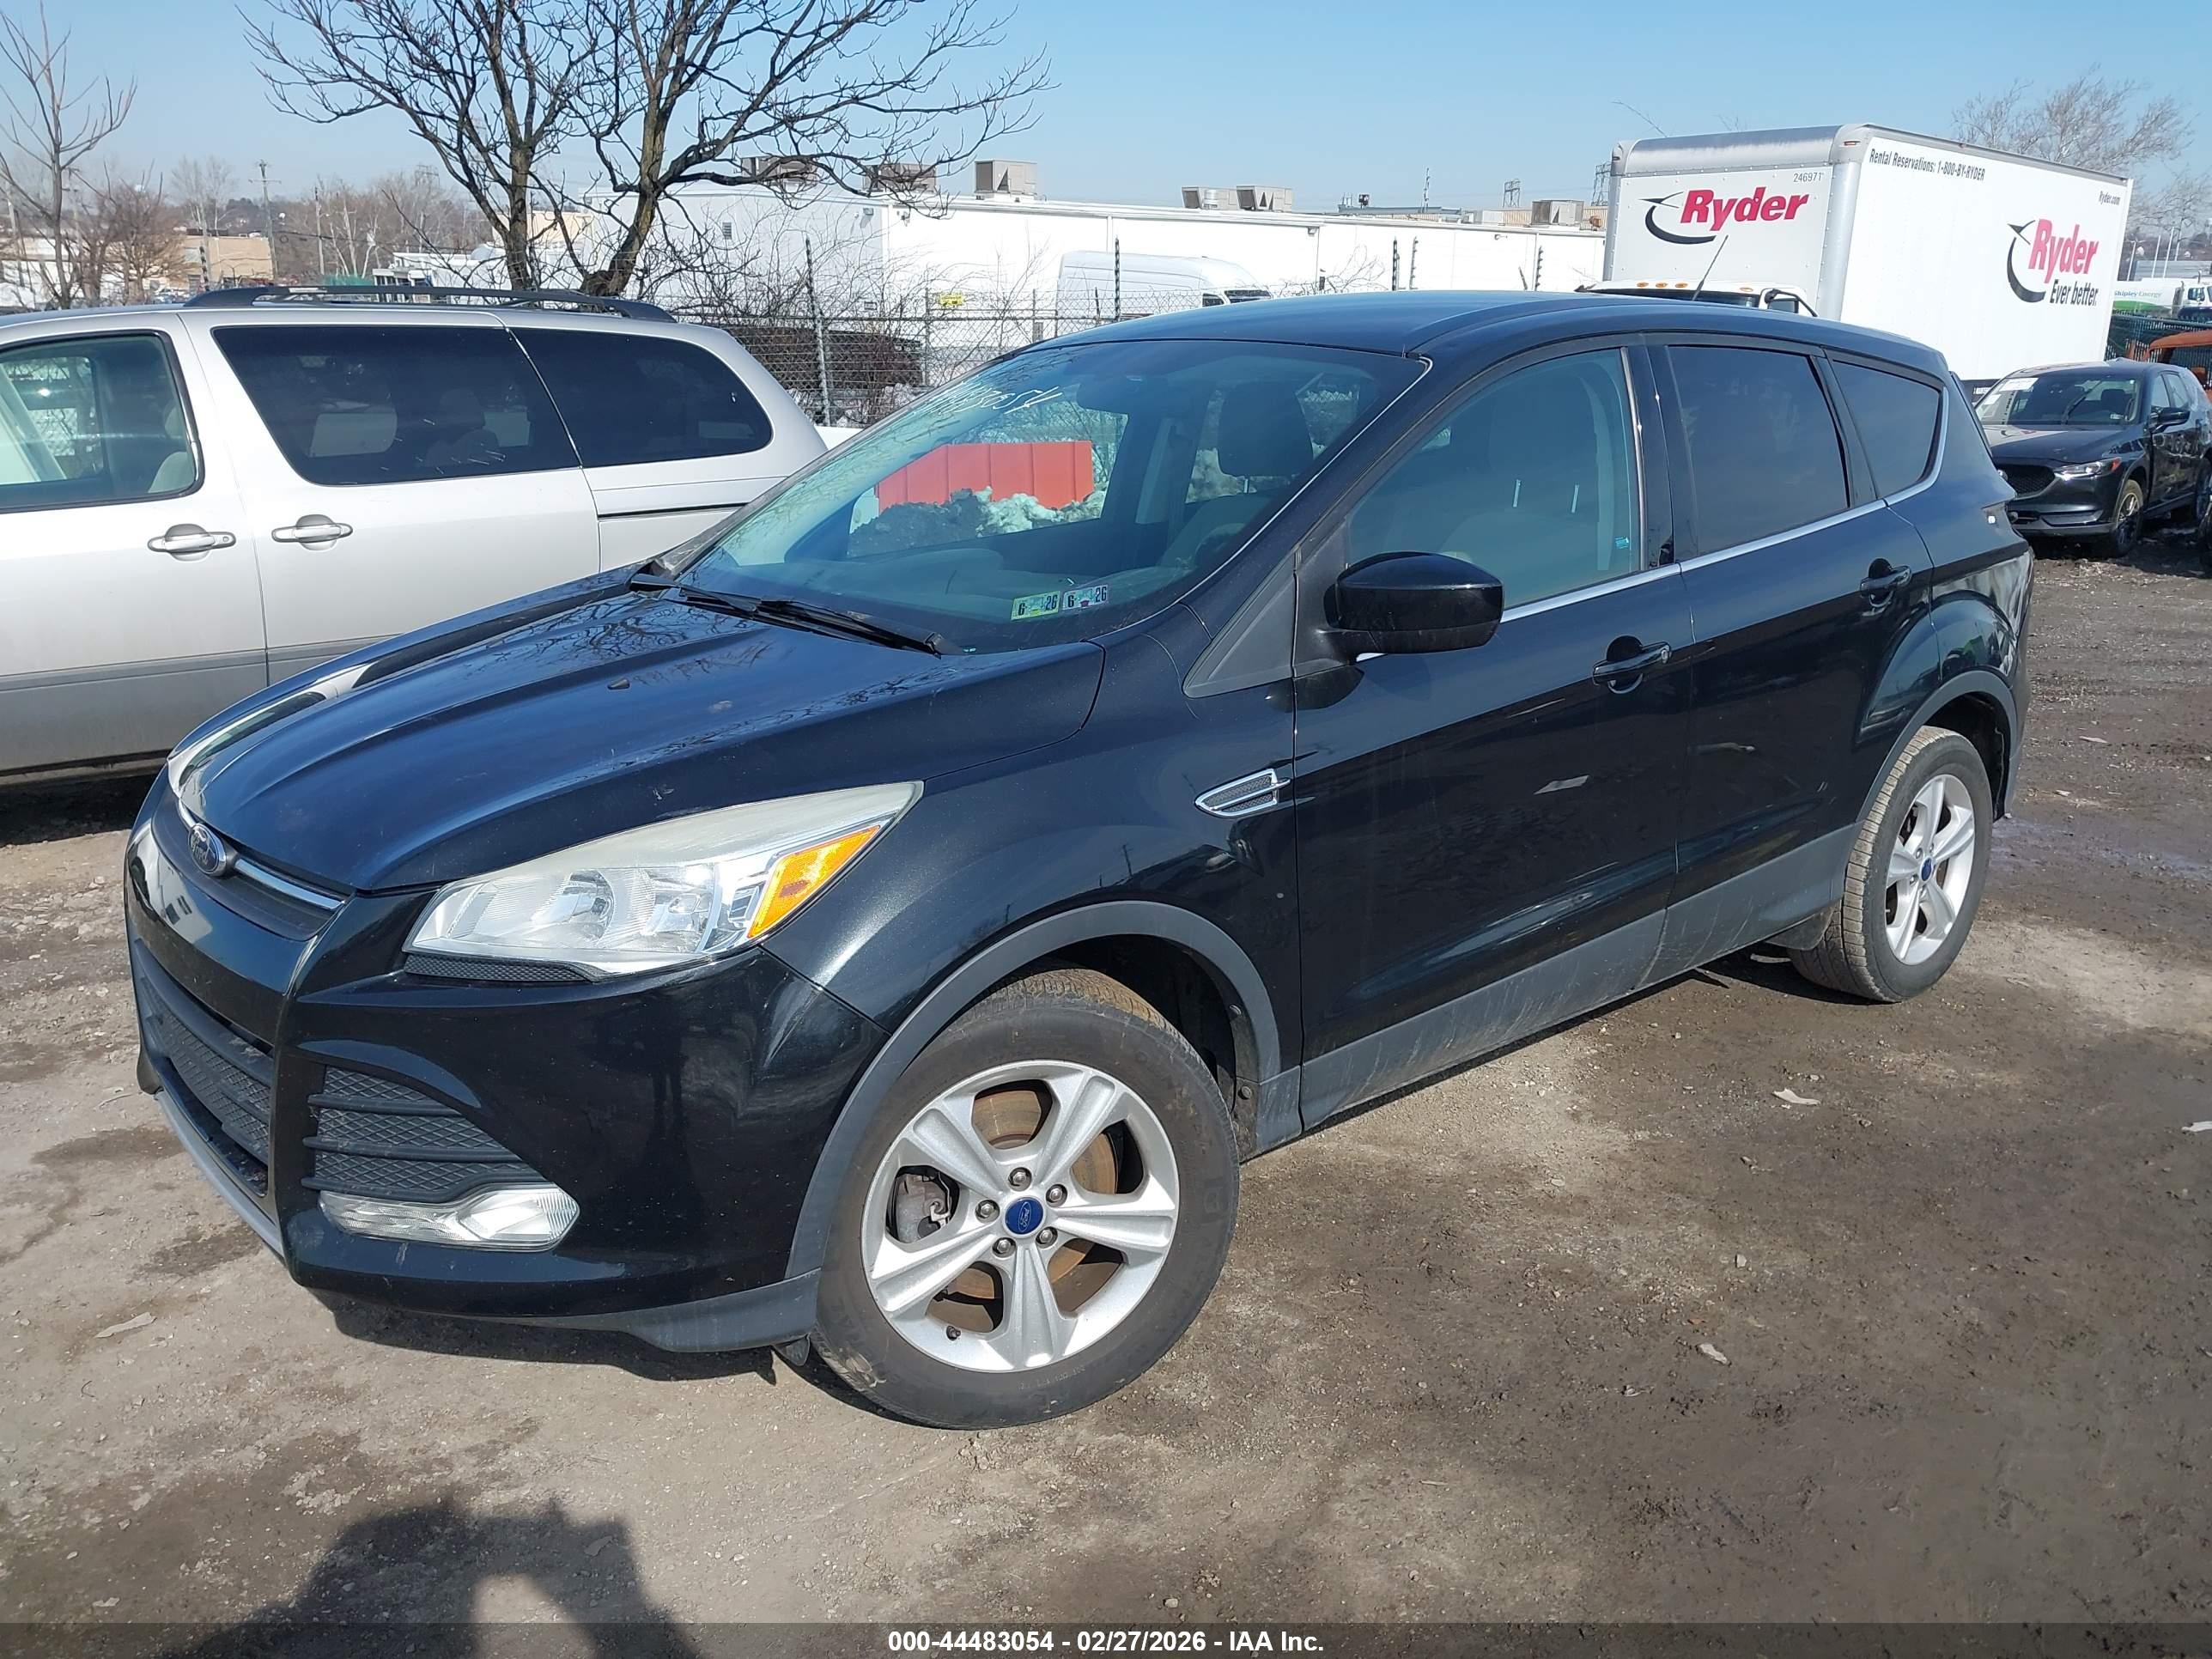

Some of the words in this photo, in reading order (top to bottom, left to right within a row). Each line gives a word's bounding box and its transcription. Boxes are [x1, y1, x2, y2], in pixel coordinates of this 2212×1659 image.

[1869, 149, 1892, 166] Rental
[1893, 152, 1936, 173] Reservations:
[1936, 161, 1986, 181] 1-800-BY-RYDER
[1793, 172, 1822, 183] 246971
[1680, 186, 1810, 232] Ryder
[2027, 218, 2100, 283] Ryder
[2049, 279, 2072, 304] Ever
[1018, 602, 1026, 616] 6
[1044, 594, 1058, 611] 26
[1068, 594, 1075, 608] 6
[1095, 586, 1108, 603] 26
[1019, 1205, 1030, 1229] Ford
